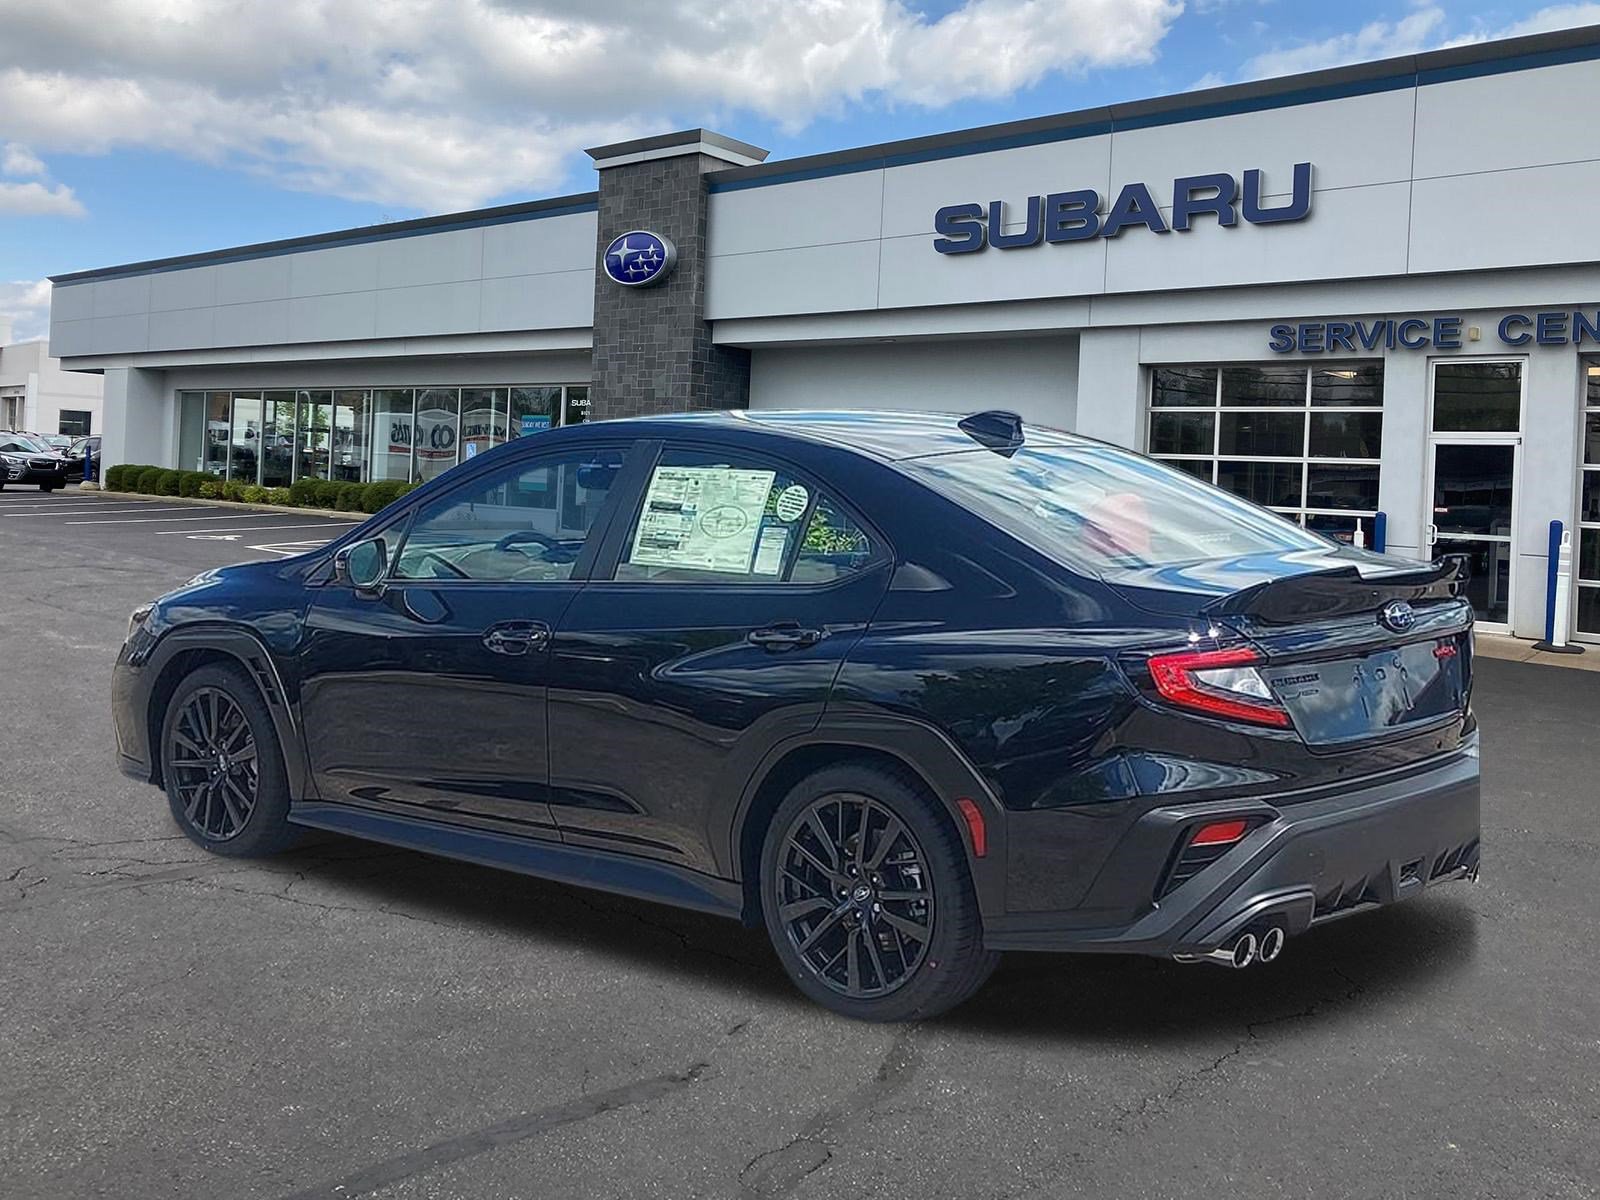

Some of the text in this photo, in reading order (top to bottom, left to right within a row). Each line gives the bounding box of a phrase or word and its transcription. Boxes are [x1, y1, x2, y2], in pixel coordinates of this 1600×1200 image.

[933, 162, 1313, 255] SUBARU
[1269, 311, 1600, 353] SERVICE CEN
